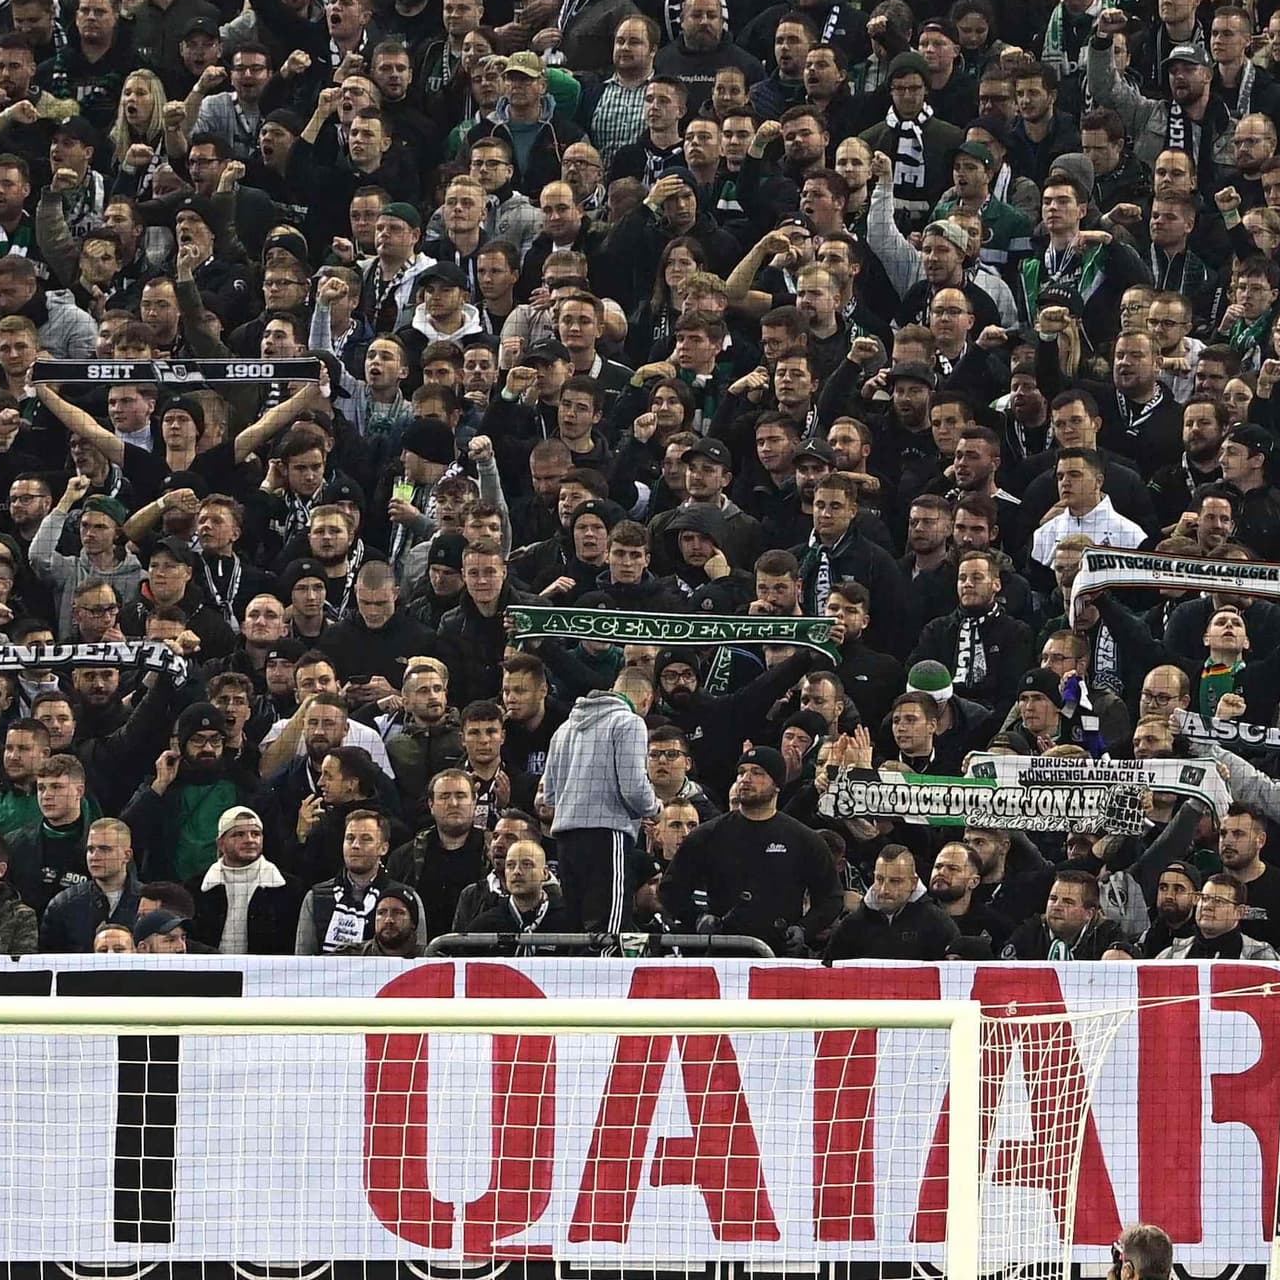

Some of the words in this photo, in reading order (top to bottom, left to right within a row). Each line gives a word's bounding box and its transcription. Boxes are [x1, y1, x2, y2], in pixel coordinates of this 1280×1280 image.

[87, 364, 135, 379] SEIT
[225, 363, 275, 379] 1900
[1086, 553, 1172, 573] DEUTSCHER
[1175, 561, 1280, 582] POKALSIEGER
[541, 614, 798, 639] ASCENDENTE
[1030, 757, 1087, 769] BORUSSIA
[1018, 767, 1134, 783] MÖNCHENGLADBACH
